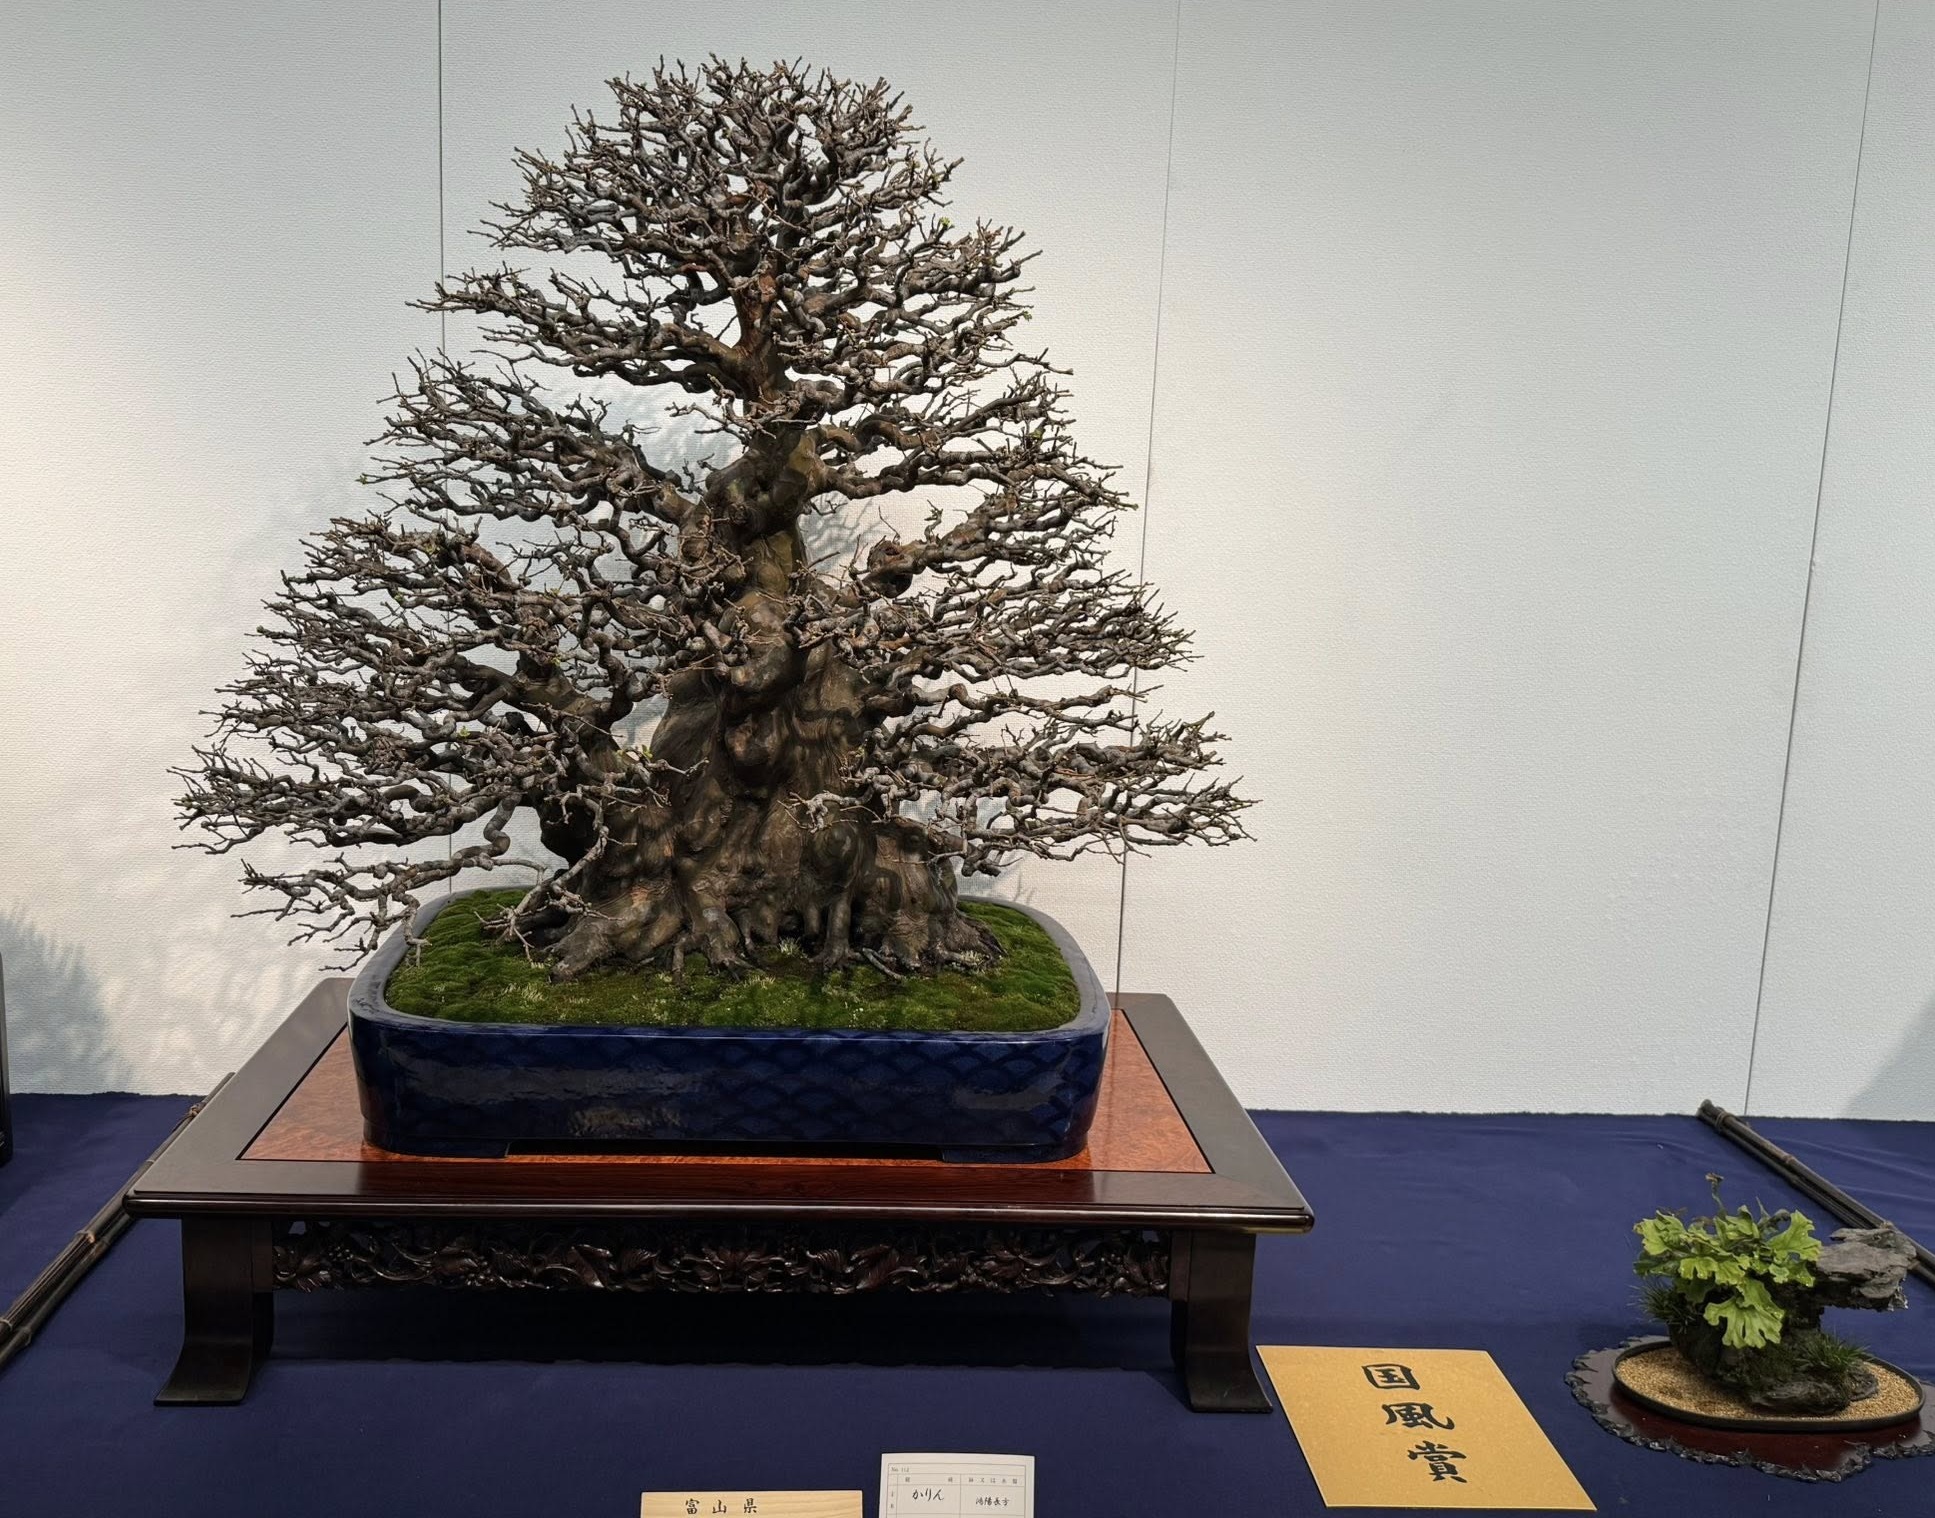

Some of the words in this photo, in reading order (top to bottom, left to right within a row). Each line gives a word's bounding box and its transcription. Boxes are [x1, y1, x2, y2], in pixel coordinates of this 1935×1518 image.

[1361, 1363, 1467, 1483] 国風賞
[912, 1488, 944, 1502] かりん
[685, 1498, 758, 1515] 富山県
